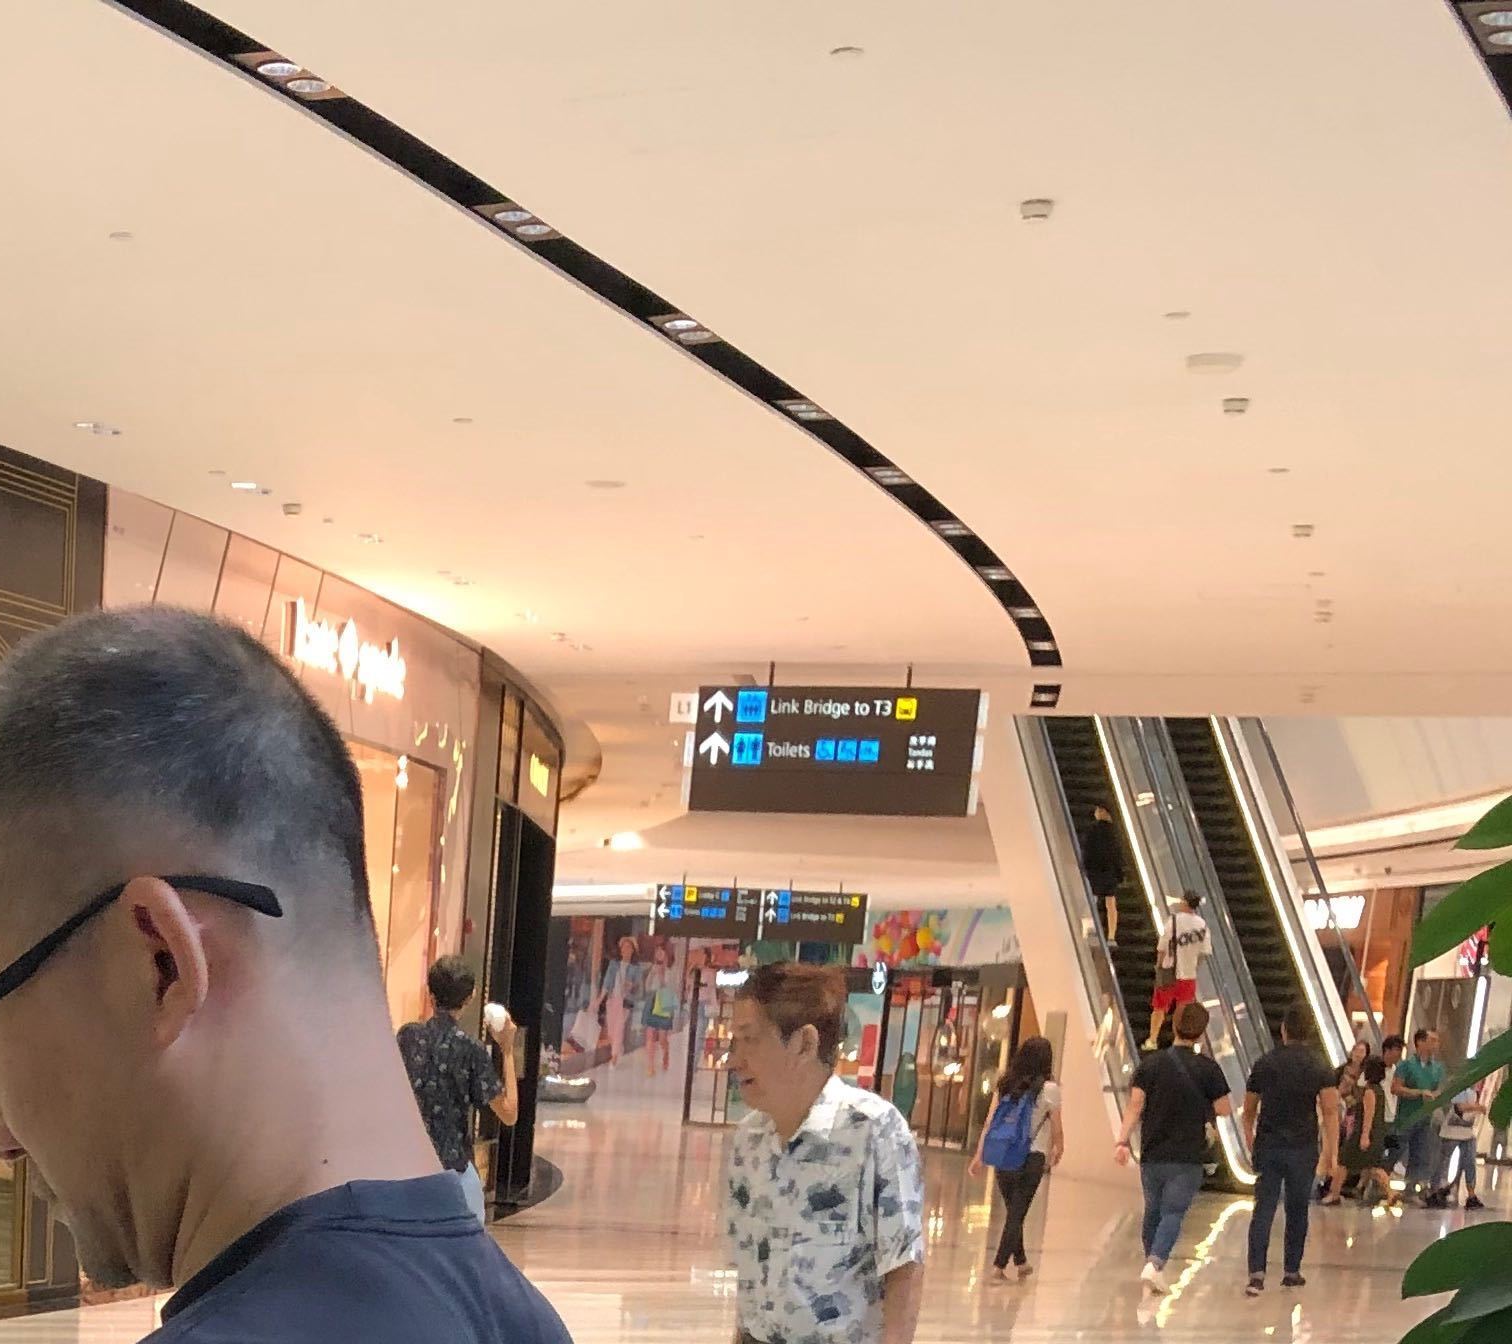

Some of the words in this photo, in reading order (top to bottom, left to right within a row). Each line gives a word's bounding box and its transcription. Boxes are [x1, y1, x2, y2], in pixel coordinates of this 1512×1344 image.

[770, 698, 800, 715] Link
[803, 698, 851, 719] Bridge
[854, 700, 871, 716] to
[873, 699, 893, 716] T3
[767, 741, 811, 758] Toilets
